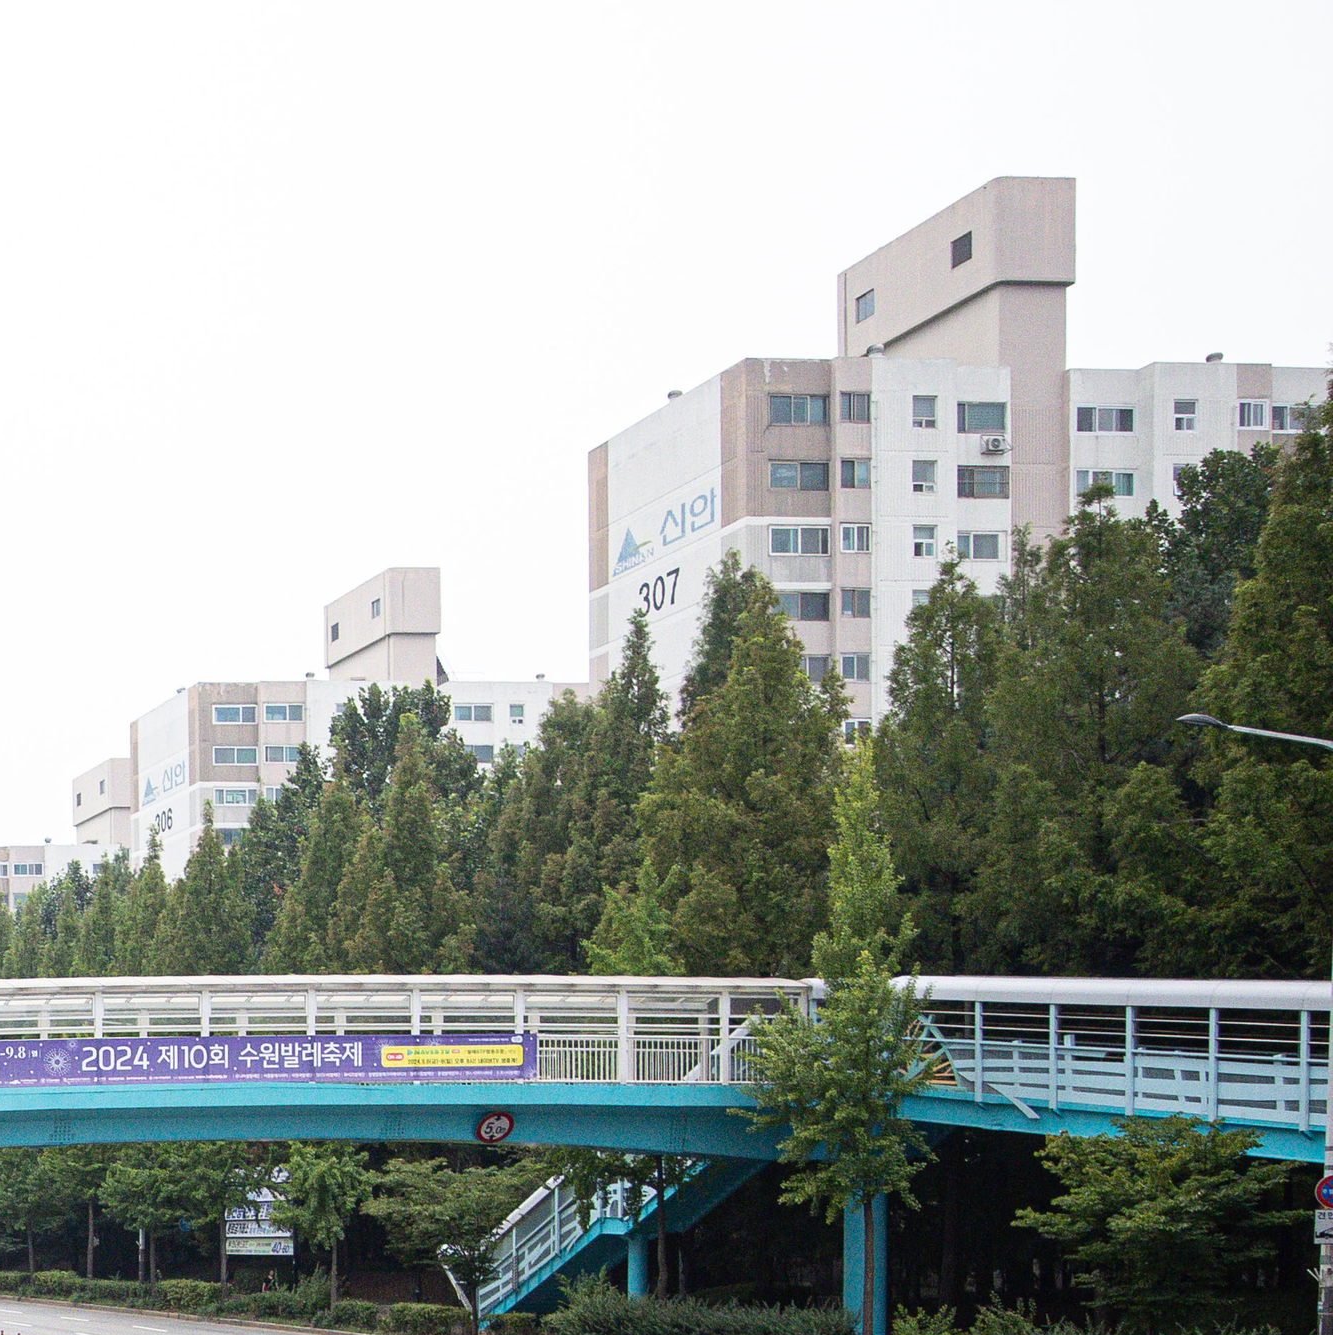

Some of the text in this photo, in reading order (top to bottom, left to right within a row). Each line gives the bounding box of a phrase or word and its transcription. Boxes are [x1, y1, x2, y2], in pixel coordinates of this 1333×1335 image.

[660, 487, 717, 547] 신안
[613, 547, 654, 575] SHINAN
[639, 567, 680, 618] 307
[162, 760, 186, 793] 신안
[155, 807, 173, 836] 306
[81, 1042, 362, 1071] 2024 제10회 수원발레축제
